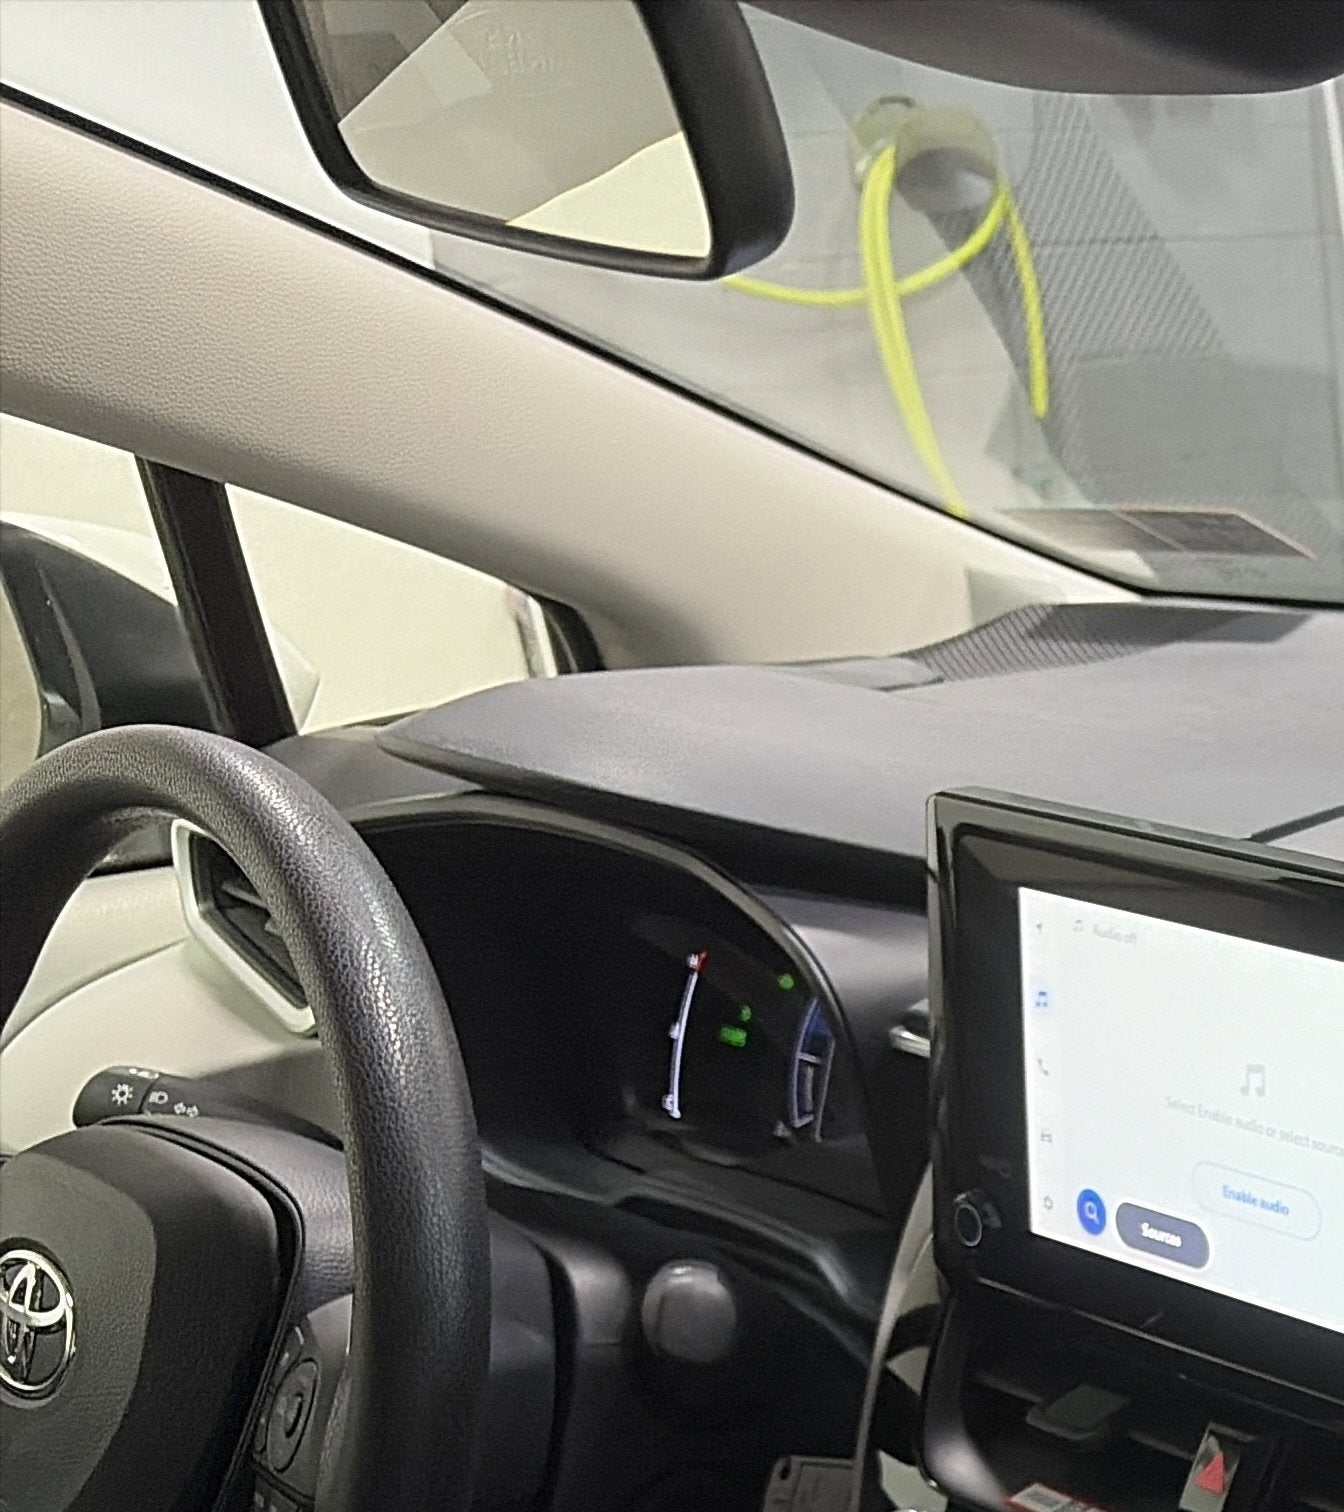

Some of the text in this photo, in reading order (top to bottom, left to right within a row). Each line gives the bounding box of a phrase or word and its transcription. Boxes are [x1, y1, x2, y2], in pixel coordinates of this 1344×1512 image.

[1198, 1104, 1233, 1126] Enable
[1235, 1118, 1265, 1135] audio
[1266, 1126, 1278, 1138] or
[1280, 1130, 1311, 1148] select
[1222, 1184, 1290, 1216] Enable audio
